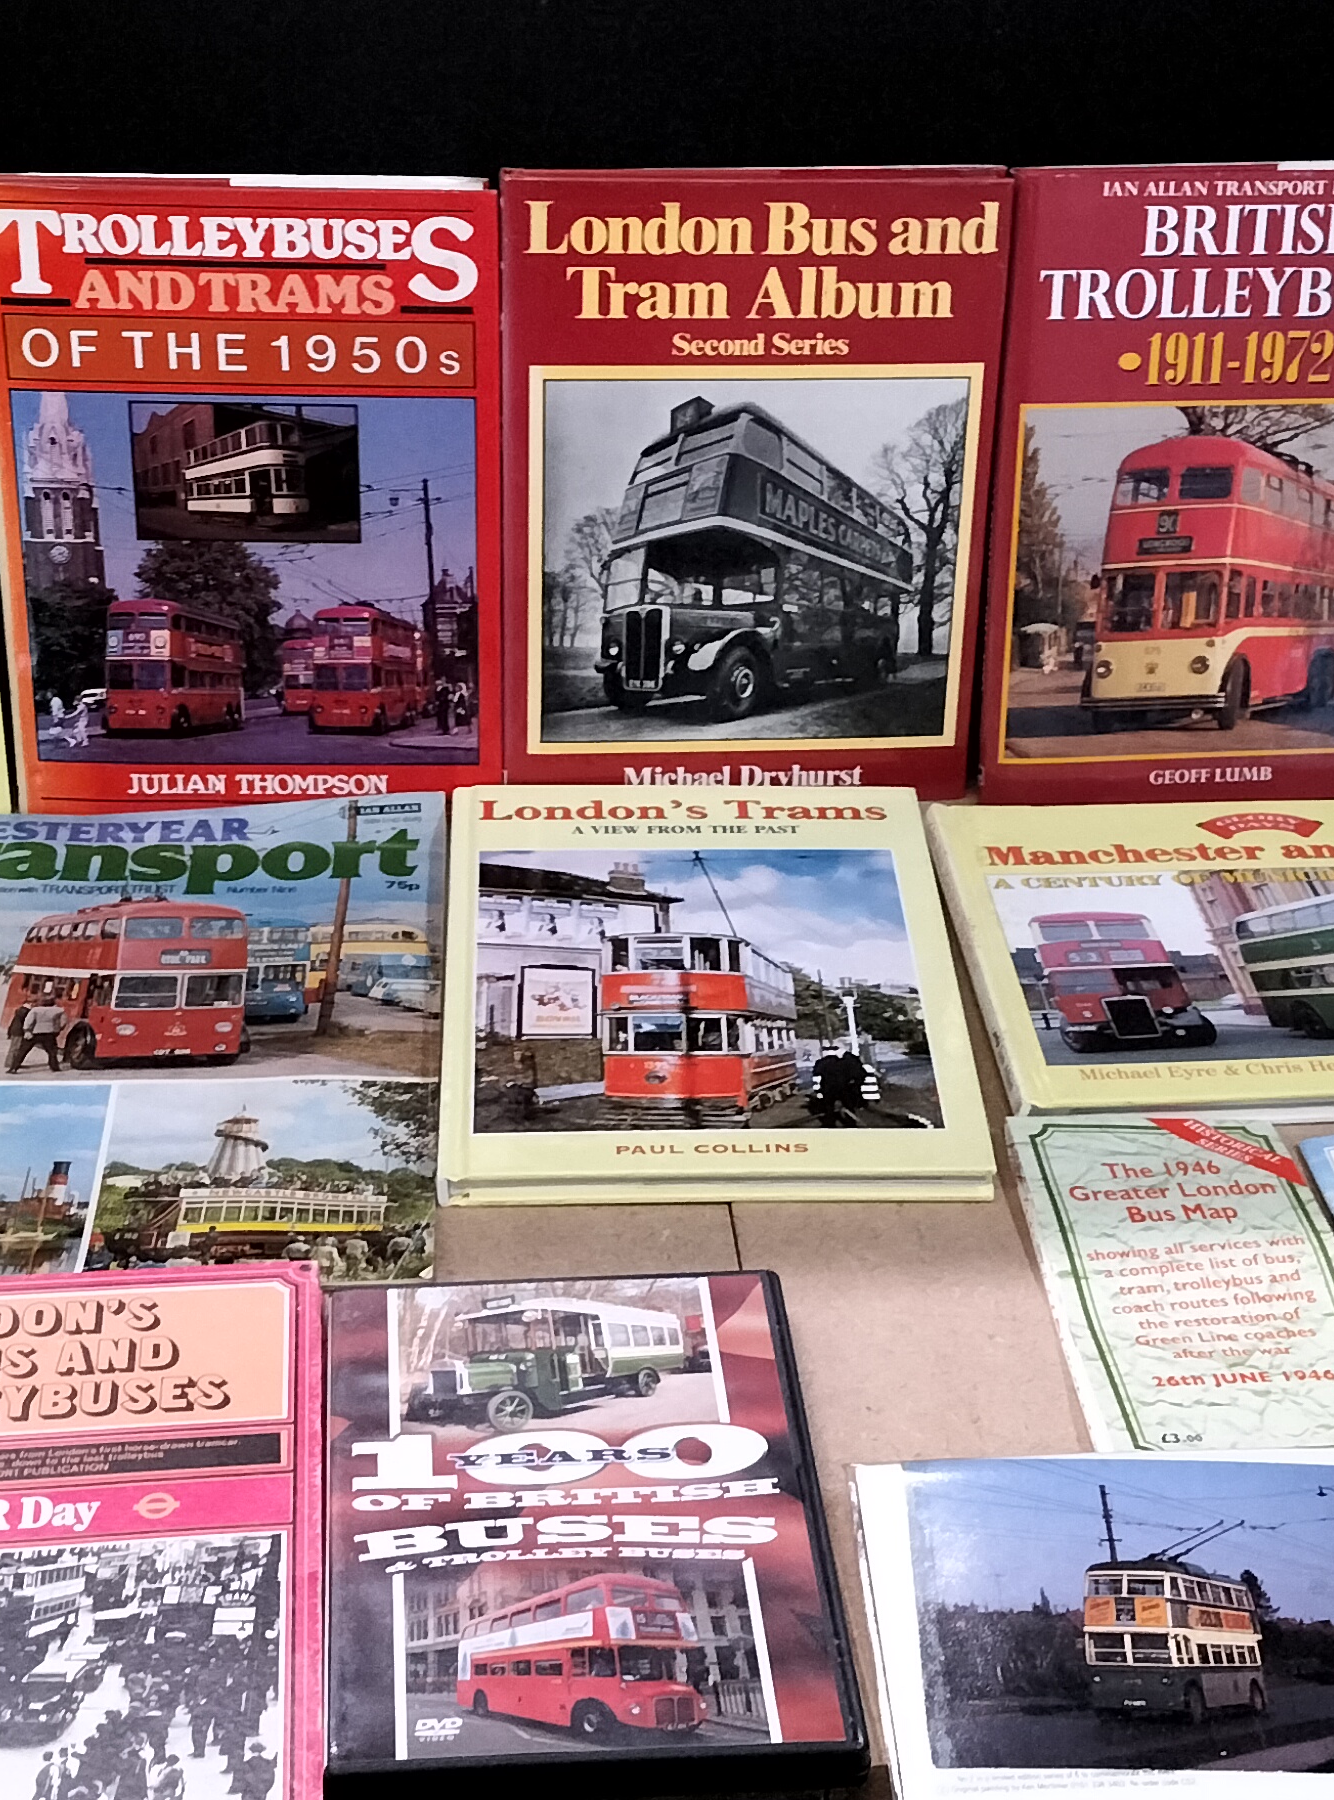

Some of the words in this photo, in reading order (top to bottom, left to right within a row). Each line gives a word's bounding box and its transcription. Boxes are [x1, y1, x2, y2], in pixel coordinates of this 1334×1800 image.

[1102, 180, 1140, 198] IAN
[1144, 180, 1209, 197] ALLAN
[1215, 179, 1328, 197] TRANSPORT
[523, 200, 754, 256] London
[762, 201, 878, 256] Bus
[887, 201, 999, 255] and
[75, 270, 196, 312] AND
[198, 272, 395, 316] TRAMS
[566, 266, 731, 319] Tram
[745, 265, 954, 319] Album
[21, 327, 99, 368] OF
[121, 329, 248, 372] THE
[270, 333, 461, 376] 1950s
[670, 331, 766, 356] Second
[771, 332, 850, 356] Series
[765, 483, 836, 542] MAPLES
[127, 773, 226, 795] JULIAN
[235, 773, 389, 795] THOMPSON
[623, 764, 731, 786] Michael
[1149, 767, 1211, 786] GEOFF
[1214, 766, 1273, 783] LUMB
[478, 799, 707, 821] London's
[724, 800, 888, 821] Trams
[571, 825, 584, 835] A
[589, 825, 640, 835] VIEW
[647, 825, 702, 835] FROM
[708, 825, 748, 835] THE
[754, 825, 800, 835] PAST
[985, 843, 1266, 866] Manchester
[41, 883, 127, 895] TRANSPORT
[131, 884, 176, 895] TRUST
[385, 880, 420, 891] 75p
[993, 877, 1015, 890] A
[1021, 874, 1162, 890] CENTURY
[1172, 871, 1217, 887] OF
[1079, 1066, 1161, 1081] Michael
[1167, 1064, 1217, 1080] Eyre
[1224, 1064, 1241, 1076] &
[1245, 1062, 1304, 1075] Chris
[615, 1143, 684, 1156] PAUL
[694, 1142, 809, 1155] COLLINS
[1183, 1119, 1282, 1165] HISTORICAL
[1195, 1138, 1253, 1163] SERIES
[1102, 1162, 1153, 1180] The
[1165, 1160, 1220, 1177] 1946
[1068, 1184, 1169, 1202] Greater
[1177, 1180, 1276, 1198] London
[1126, 1206, 1176, 1223] Bus
[1181, 1203, 1238, 1223] Map
[1086, 1244, 1160, 1263] showing
[1164, 1242, 1185, 1256] all
[1189, 1239, 1261, 1254] services
[1265, 1235, 1305, 1247] with
[1103, 1269, 1114, 1278] a
[1119, 1260, 1204, 1279] complete
[1209, 1256, 1236, 1270] list
[1242, 1254, 1259, 1267] of
[1265, 1252, 1301, 1266] bus,
[1119, 1281, 1170, 1296] tram,
[1174, 1273, 1263, 1293] trolleybus
[1269, 1269, 1301, 1283] and
[1112, 1301, 1165, 1316] coach
[1170, 1296, 1228, 1311] routes
[1233, 1289, 1317, 1306] following
[1138, 1318, 1169, 1330] the
[1174, 1312, 1278, 1328] restoration
[1283, 1307, 1301, 1321] of
[1134, 1333, 1192, 1347] Green
[1198, 1331, 1238, 1343] Line
[1244, 1327, 1317, 1341] coaches
[56, 1335, 179, 1376] AND
[1173, 1347, 1214, 1360] after
[1221, 1346, 1253, 1358] the
[1258, 1345, 1291, 1357] war
[1152, 1374, 1205, 1388] 26th
[1213, 1371, 1272, 1387] JUNE
[351, 1422, 769, 1491] 100
[447, 1445, 673, 1469] YEARS
[23, 1463, 110, 1477] PUBLICATION
[351, 1493, 458, 1511] OF
[463, 1477, 781, 1510] BRITISH
[17, 1497, 101, 1531] Day
[353, 1514, 778, 1562] BUSES
[385, 1560, 418, 1574] &
[422, 1548, 615, 1568] TROLLEY
[618, 1546, 747, 1560] BUSES
[415, 1717, 463, 1731] DVD
